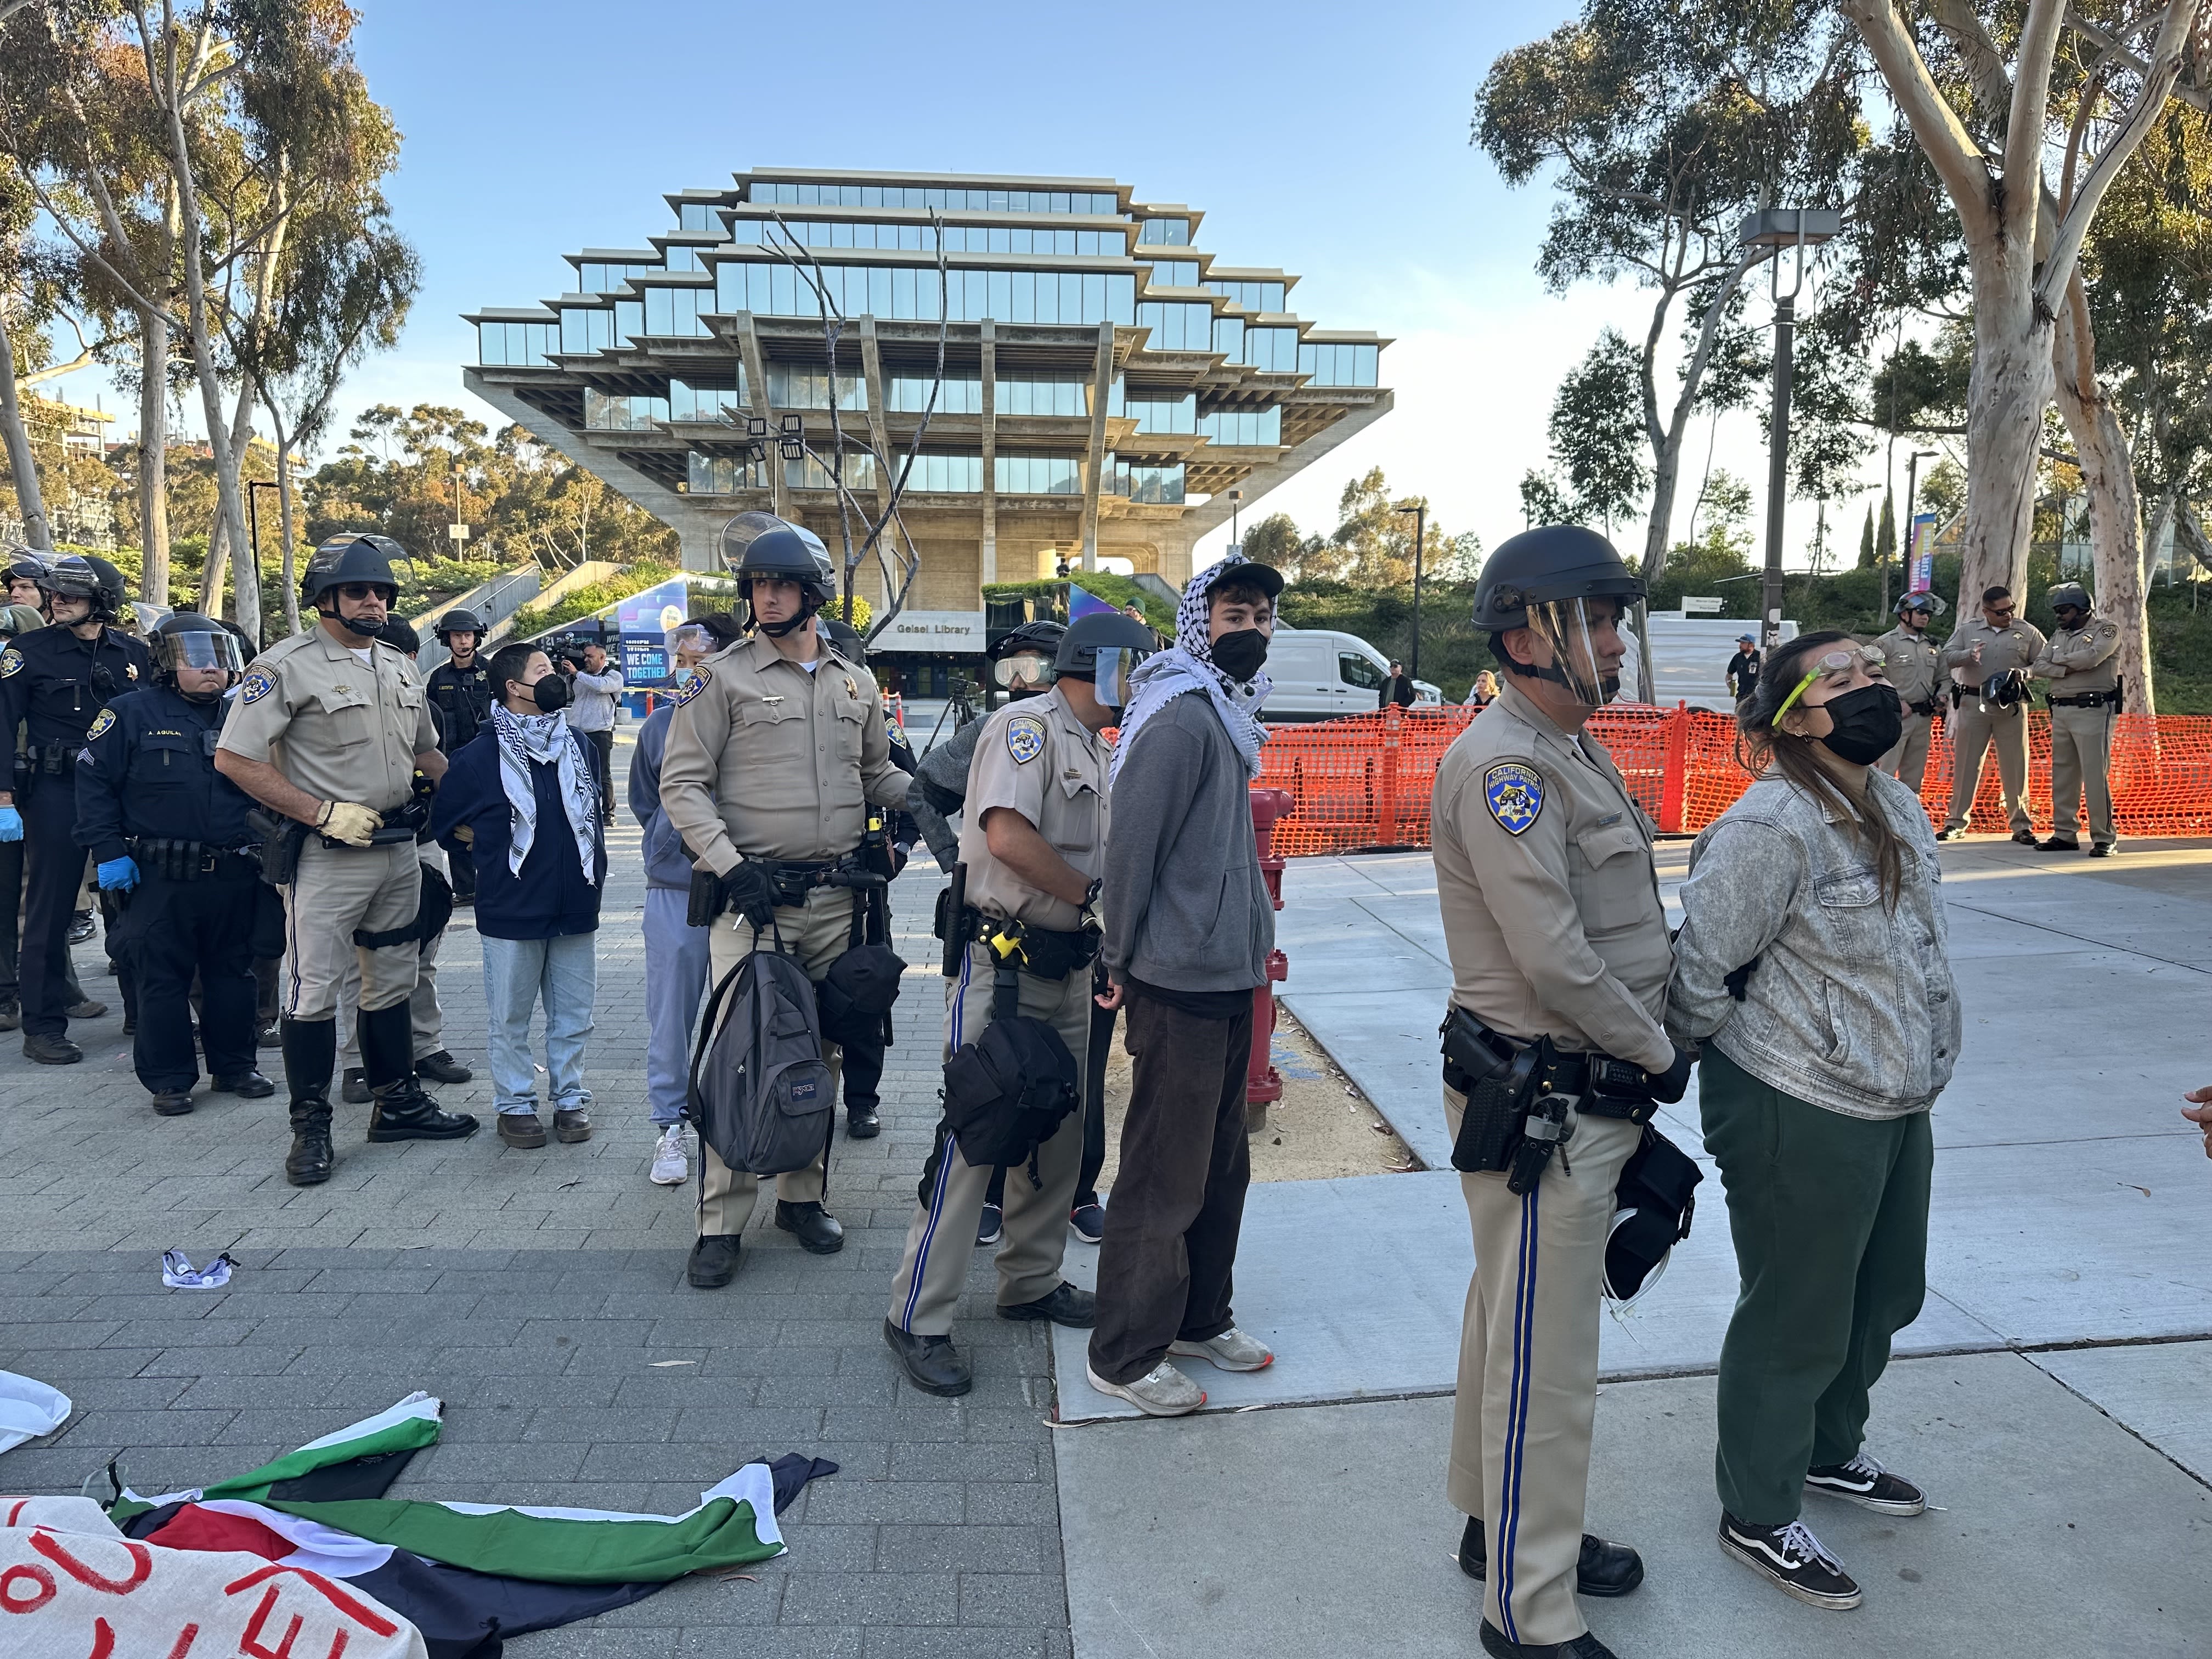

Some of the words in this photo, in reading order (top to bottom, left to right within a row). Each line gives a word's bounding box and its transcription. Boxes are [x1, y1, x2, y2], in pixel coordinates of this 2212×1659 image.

[1921, 529, 1932, 578] FURTHER
[1910, 560, 1921, 592] THINK
[897, 624, 928, 633] Geisel
[935, 625, 970, 635] Library
[627, 653, 640, 665] WE
[641, 653, 663, 665] COME
[627, 667, 667, 679] TOGETHER
[1492, 766, 1538, 783] CALIFORNIA
[1488, 774, 1518, 790] HIGHWAY
[1519, 775, 1541, 795] PATROL
